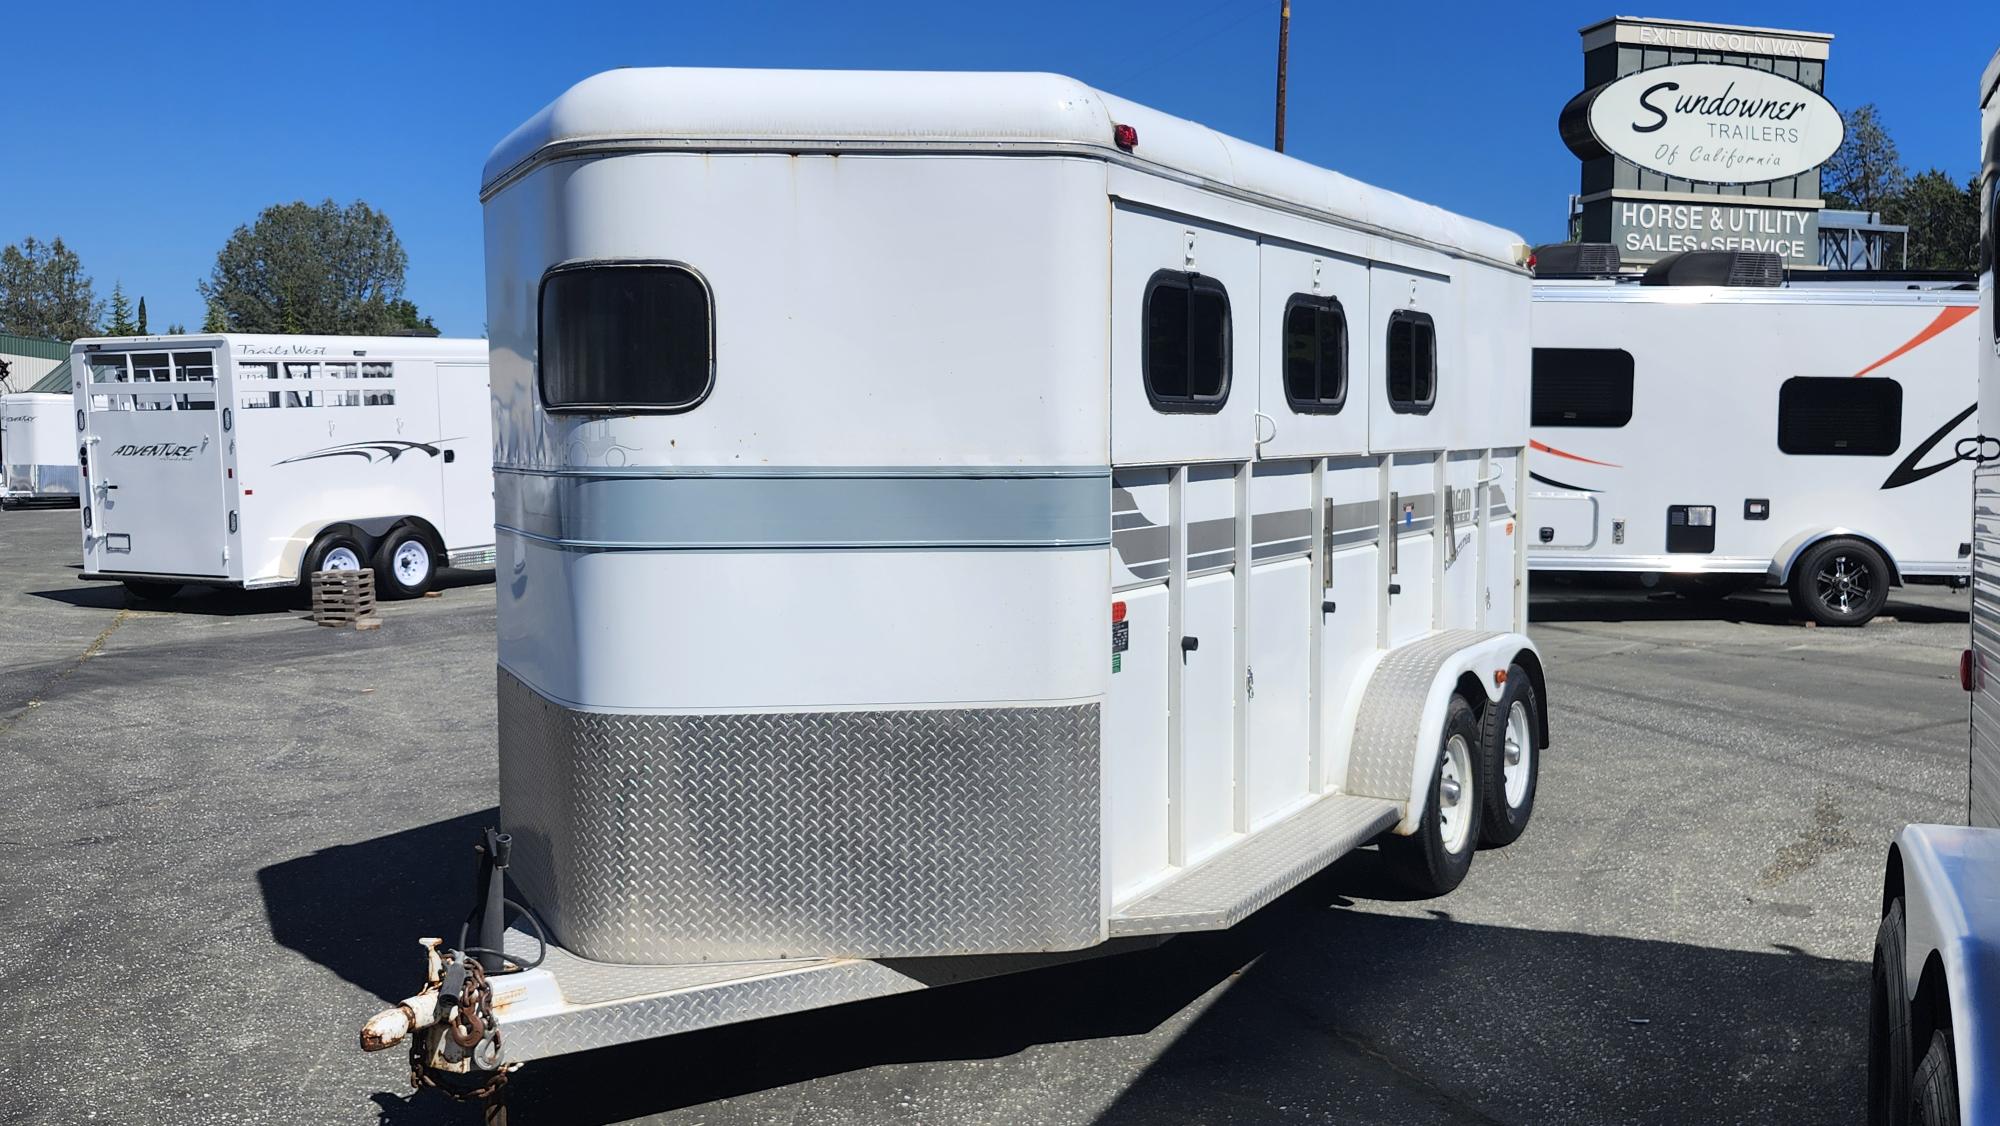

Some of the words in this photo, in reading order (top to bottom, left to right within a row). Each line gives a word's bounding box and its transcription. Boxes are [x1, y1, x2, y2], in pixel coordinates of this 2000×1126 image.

[1639, 26, 1681, 46] EXIT
[1686, 32, 1765, 54] LINCOLN
[1771, 38, 1808, 57] WAY
[1631, 81, 1807, 133] Sundowner
[1706, 122, 1799, 144] TRAILERS
[1654, 143, 1680, 166] Of
[1689, 145, 1781, 169] California
[1622, 203, 1704, 230] HORSE
[1710, 207, 1724, 231] &
[1729, 208, 1810, 235] UTILITY
[237, 344, 289, 355] Trails
[292, 344, 328, 356] West
[111, 442, 199, 457] ADVENTURE
